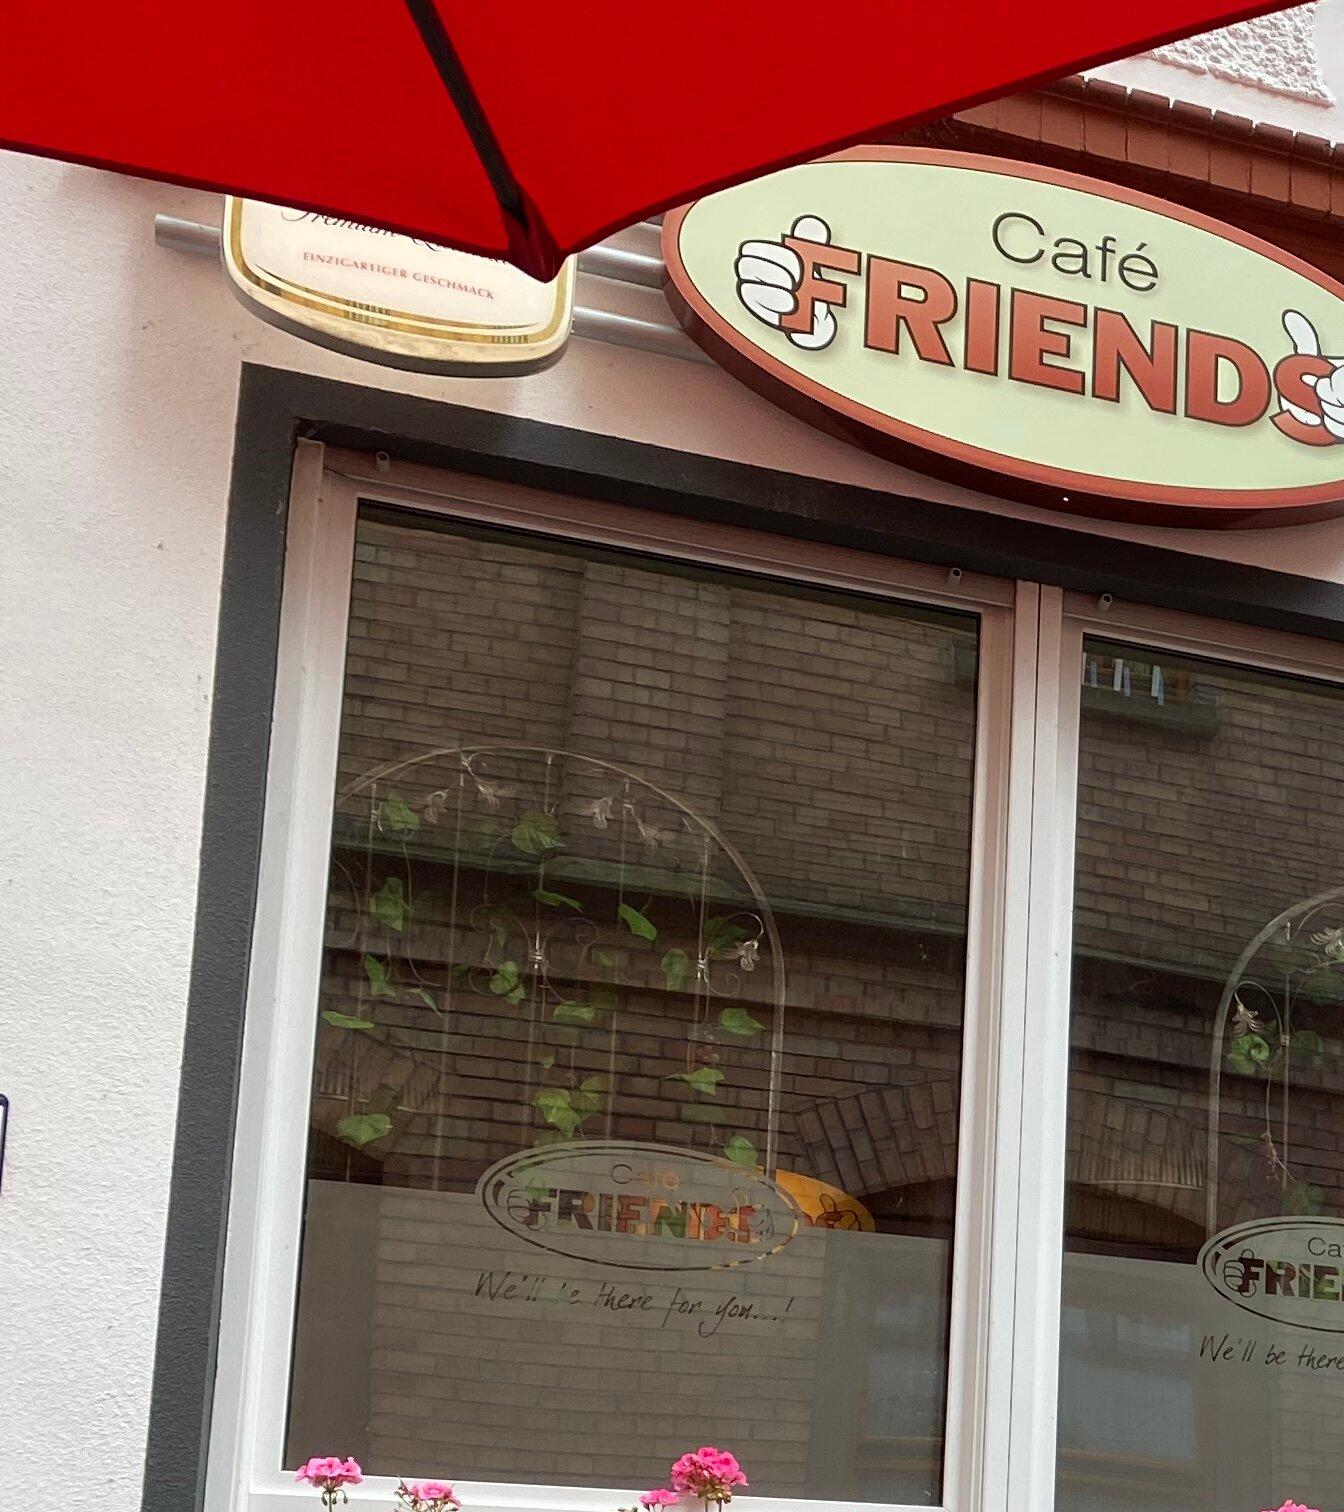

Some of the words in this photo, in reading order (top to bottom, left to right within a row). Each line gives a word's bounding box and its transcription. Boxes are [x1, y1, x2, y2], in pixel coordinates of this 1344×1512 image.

[303, 252, 408, 279] EINZIGARTIGER
[412, 272, 495, 300] GESCHMACK
[992, 212, 1159, 292] Café
[781, 234, 1338, 447] FRIENDS
